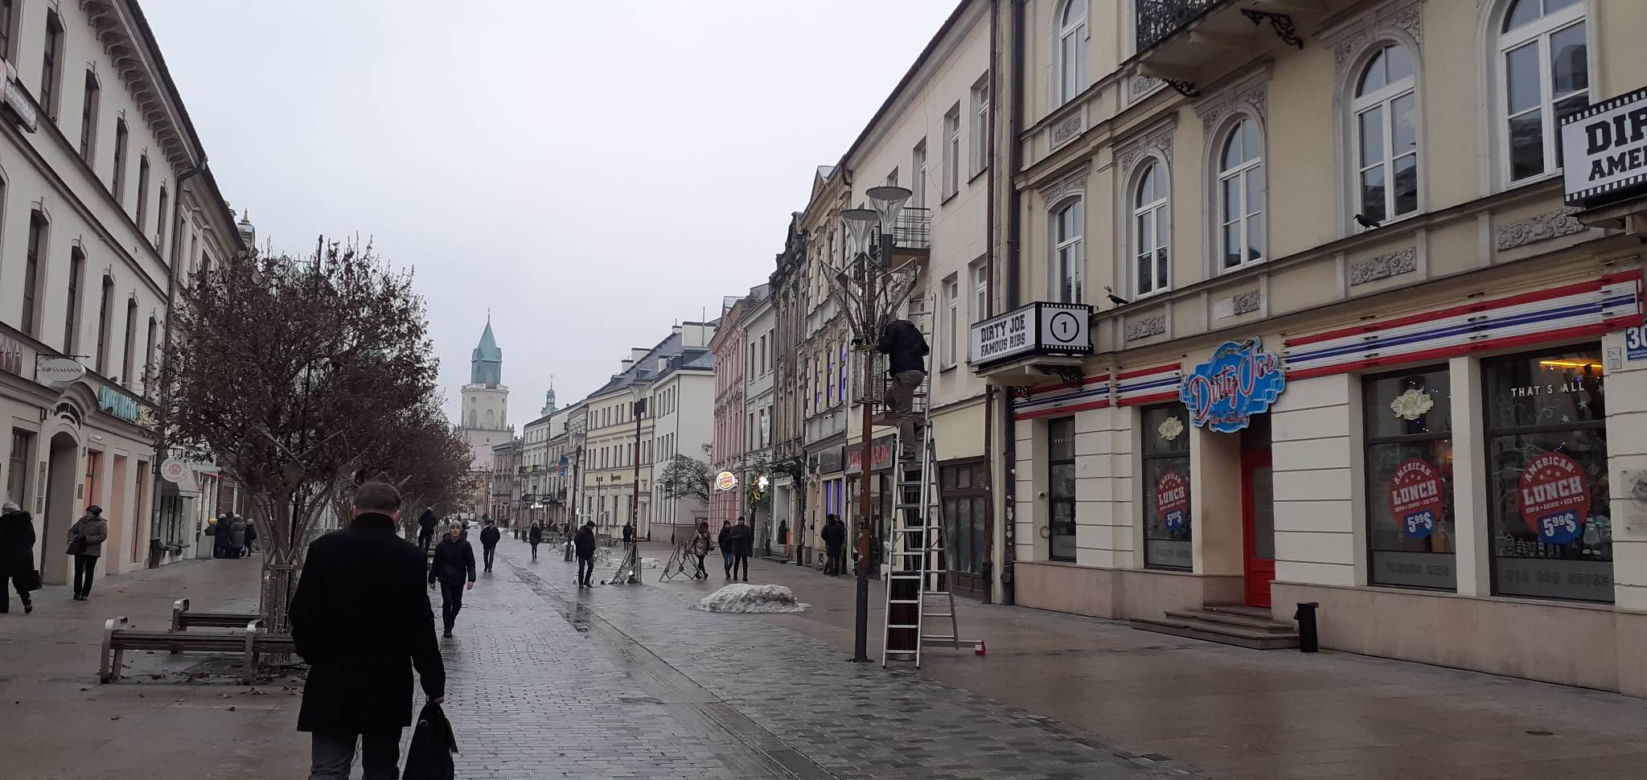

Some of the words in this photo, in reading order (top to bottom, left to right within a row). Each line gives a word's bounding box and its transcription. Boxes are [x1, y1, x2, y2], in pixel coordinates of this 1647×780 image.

[1588, 145, 1647, 181] AME
[981, 320, 1007, 343] DIRTY
[1009, 314, 1025, 334] JOE
[1061, 321, 1067, 334] 1
[981, 338, 1008, 357] FAMOUS
[1009, 332, 1026, 349] RIBS
[41, 366, 82, 374] ROSSMANN
[1189, 364, 1238, 421] Dirty
[1239, 340, 1274, 397] Joe
[1511, 384, 1553, 398] THAT'S
[1561, 381, 1585, 393] ALL
[1394, 462, 1432, 485] AMERICAN
[1525, 456, 1574, 482] AMERICAN
[1158, 486, 1185, 505] LUNCH
[1392, 480, 1438, 505] LUNCH
[1522, 475, 1583, 506] LUNCH
